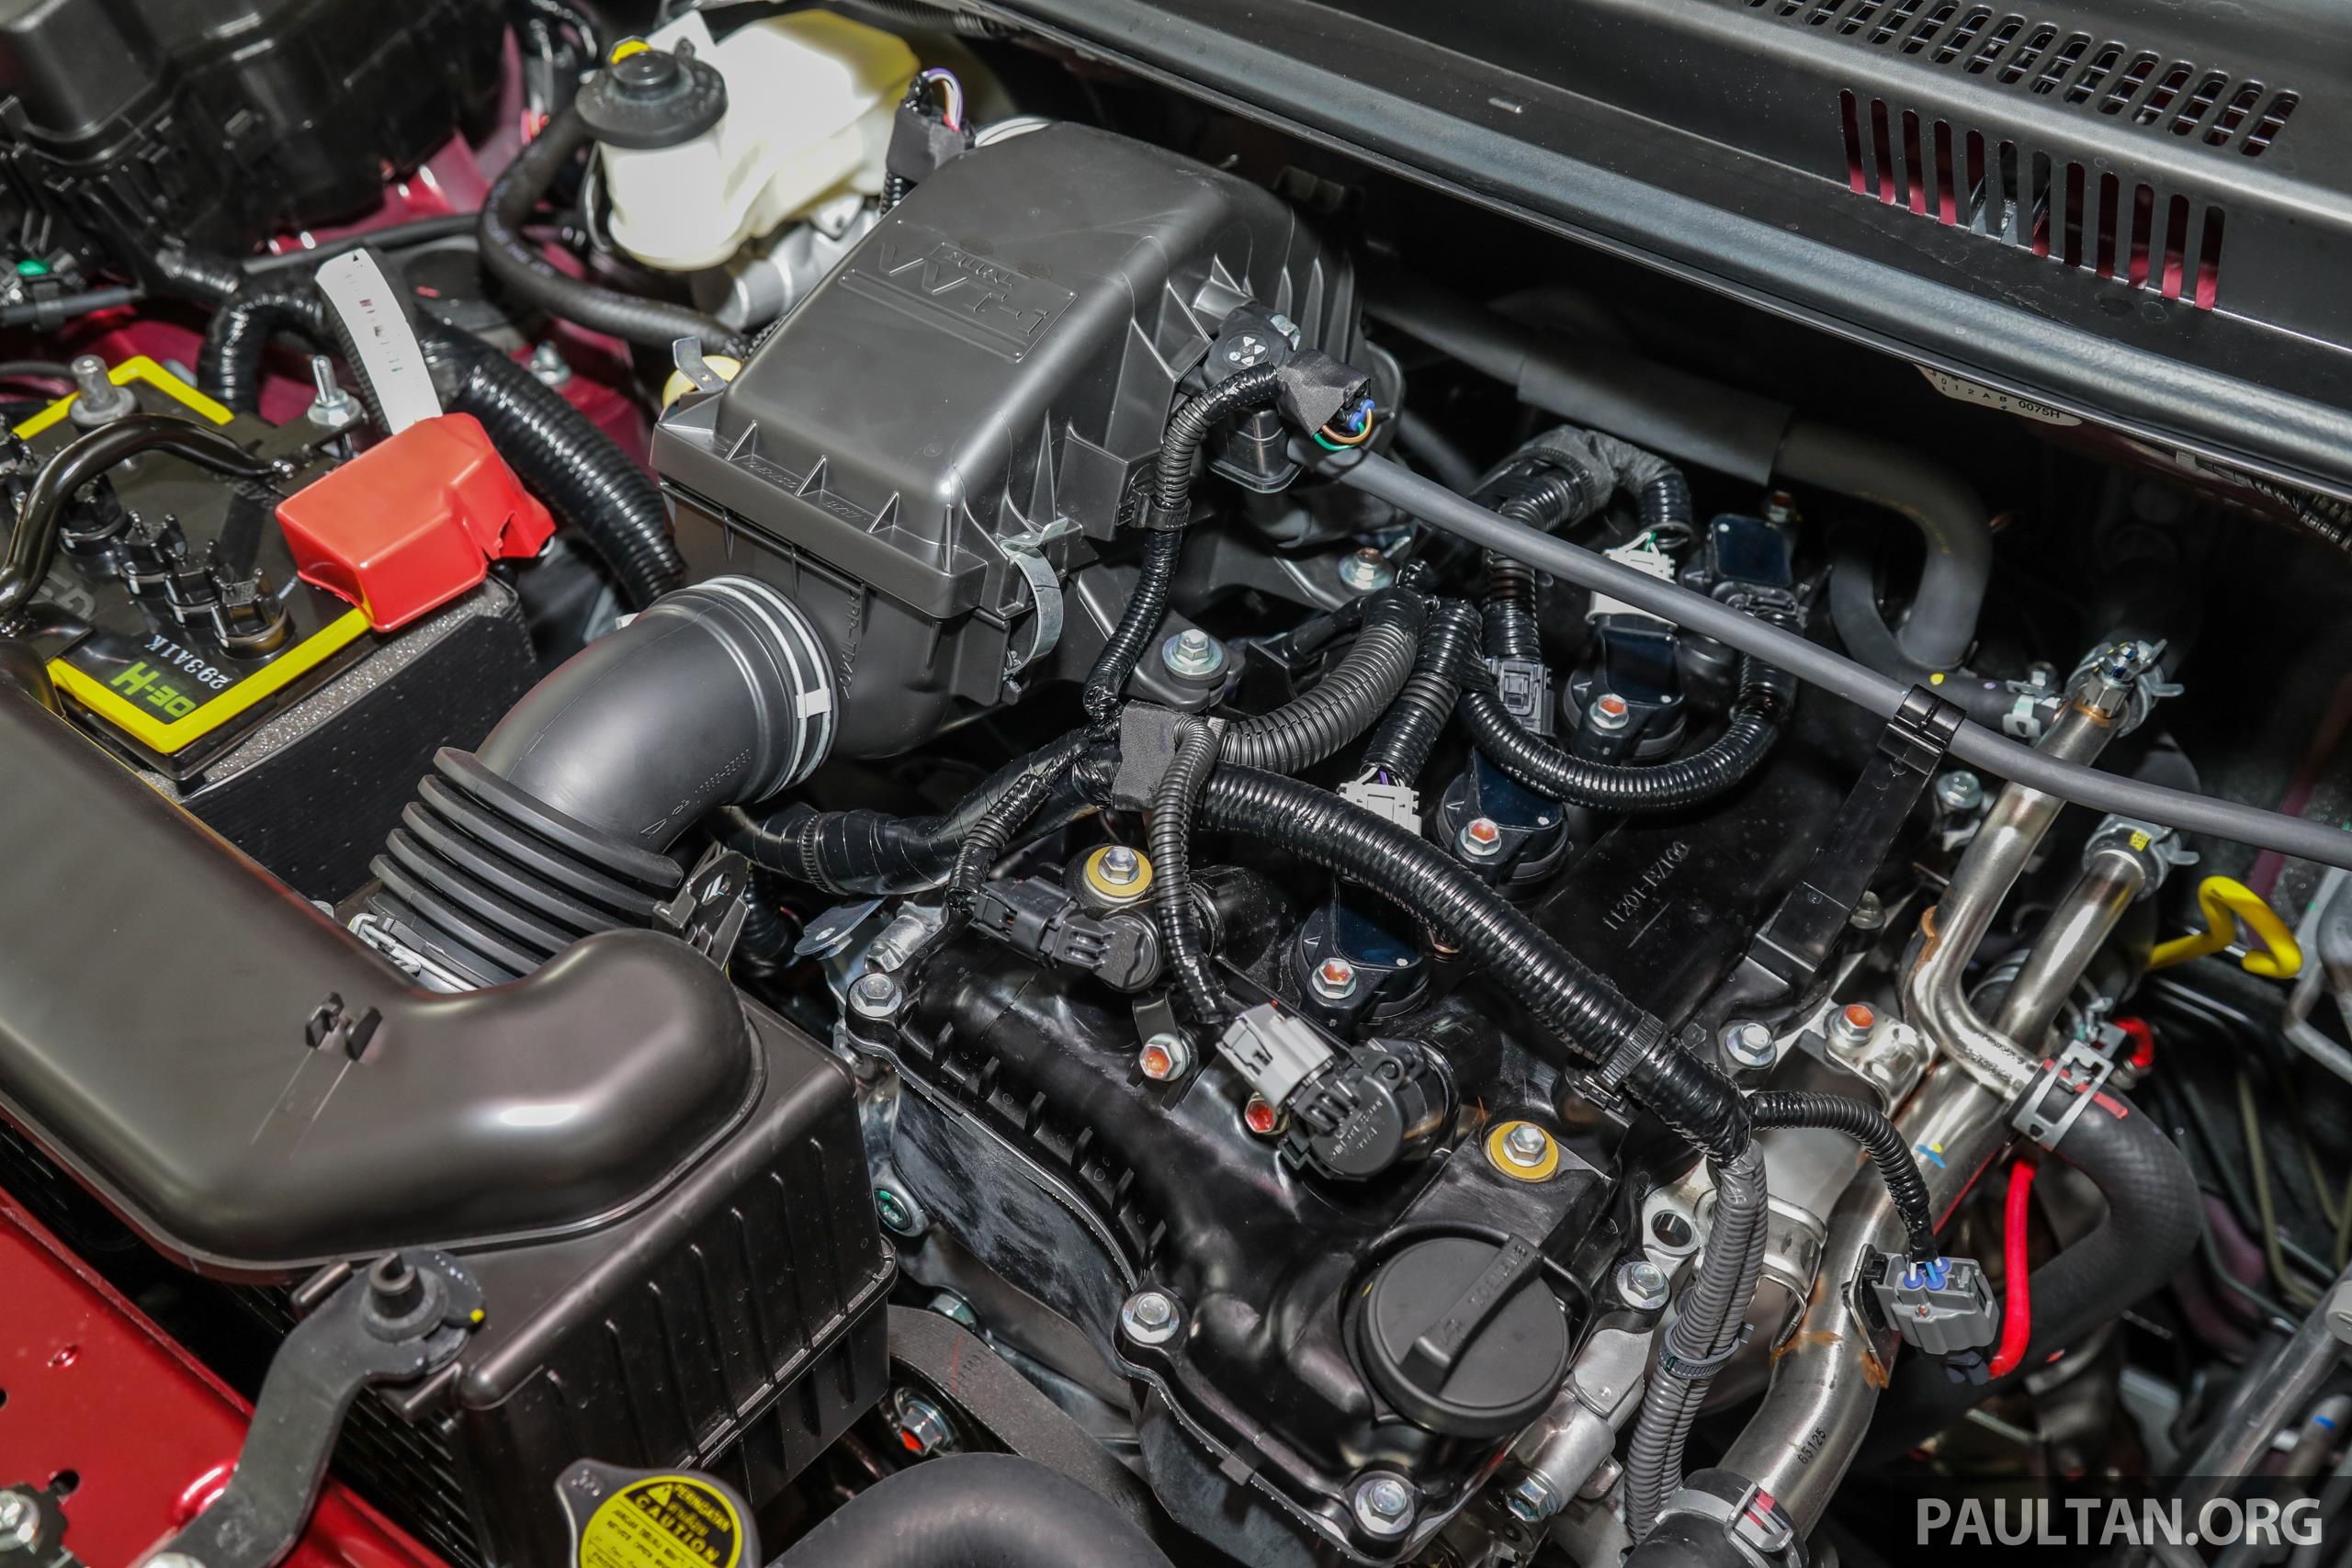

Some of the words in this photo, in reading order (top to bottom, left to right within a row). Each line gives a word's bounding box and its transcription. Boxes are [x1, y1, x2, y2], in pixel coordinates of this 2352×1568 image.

[109, 660, 198, 718] OE-H
[145, 635, 231, 690] 293A1K
[635, 1495, 720, 1562] CAUTION
